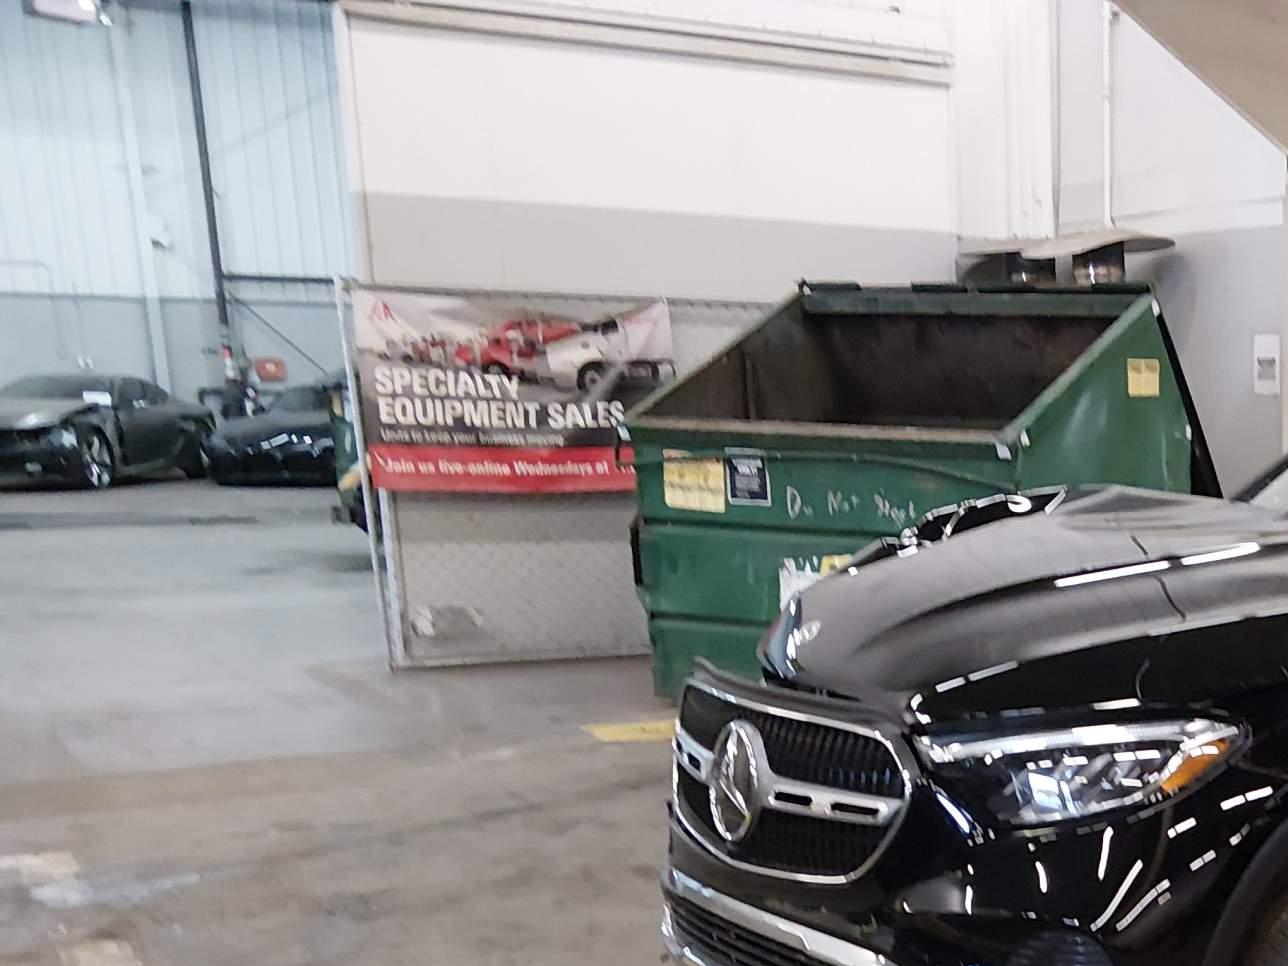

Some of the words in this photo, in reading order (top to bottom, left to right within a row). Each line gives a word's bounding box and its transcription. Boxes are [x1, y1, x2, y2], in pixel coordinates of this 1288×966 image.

[374, 366, 520, 400] SPECIALTY
[377, 397, 541, 429] EQUIPMENT
[547, 400, 626, 429] SALES
[385, 458, 415, 474] Join
[418, 461, 436, 474] us
[513, 460, 593, 477] Wednesdays
